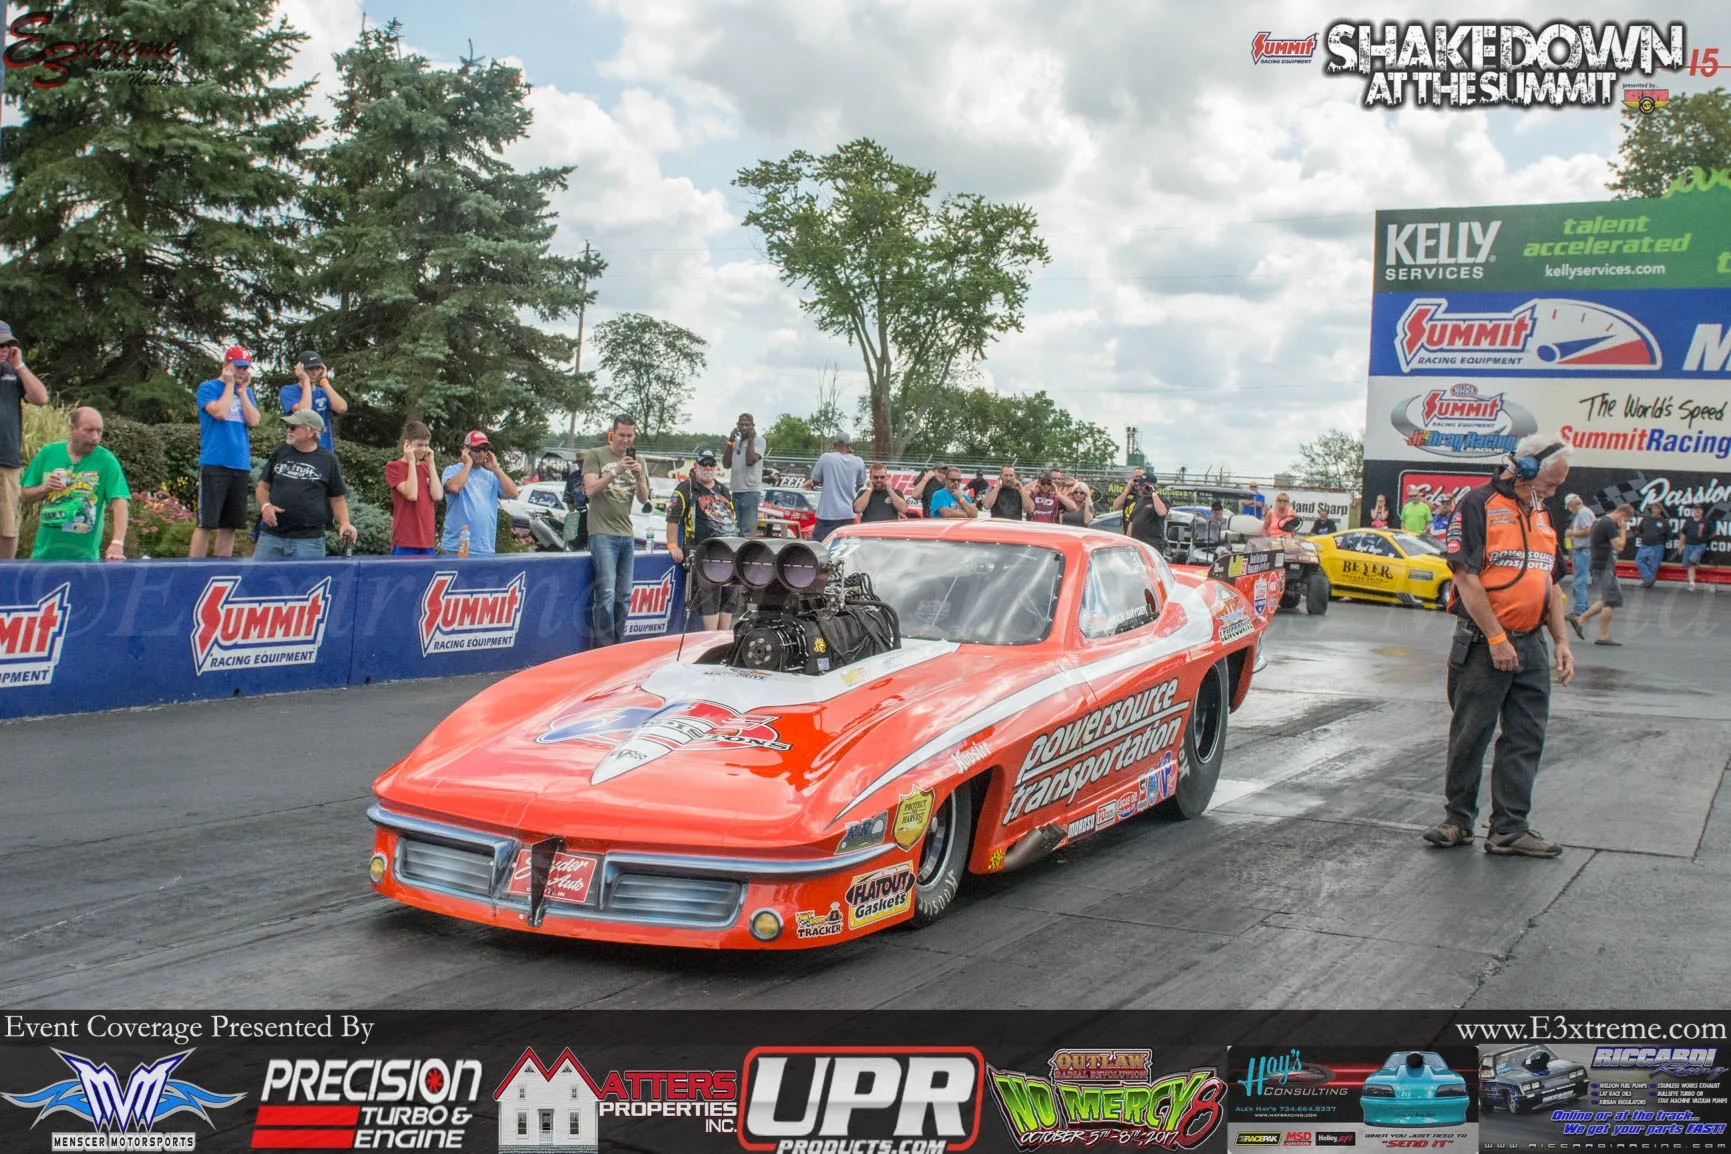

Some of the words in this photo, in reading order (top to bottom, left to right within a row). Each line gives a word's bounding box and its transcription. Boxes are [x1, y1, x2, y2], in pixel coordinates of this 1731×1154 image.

[1563, 216, 1651, 235] talent
[1386, 220, 1502, 266] KELLY
[1522, 233, 1692, 257] accelerated
[1385, 266, 1484, 281] SERVICES
[1545, 262, 1666, 281] kellyservices.com
[1417, 357, 1456, 365] RACING
[1460, 357, 1524, 365] EQUIPMENT
[1579, 392, 1616, 422] The
[1624, 394, 1674, 419] World's
[1678, 400, 1728, 428] Speed
[1428, 430, 1465, 452] Drag
[1466, 431, 1516, 453] Racing
[629, 624, 665, 633] EQUIPMENT
[433, 639, 465, 651] RACING
[467, 636, 513, 647] EQUIPMENT
[210, 655, 251, 668] RACING
[254, 651, 315, 665] EQUIPMENT
[1015, 677, 1179, 788] powersource
[1002, 716, 1182, 825] transportation
[548, 874, 584, 891] Auto
[853, 871, 910, 906] FLATOUT
[854, 893, 906, 919] Gaskets
[797, 925, 842, 937] TRACKER
